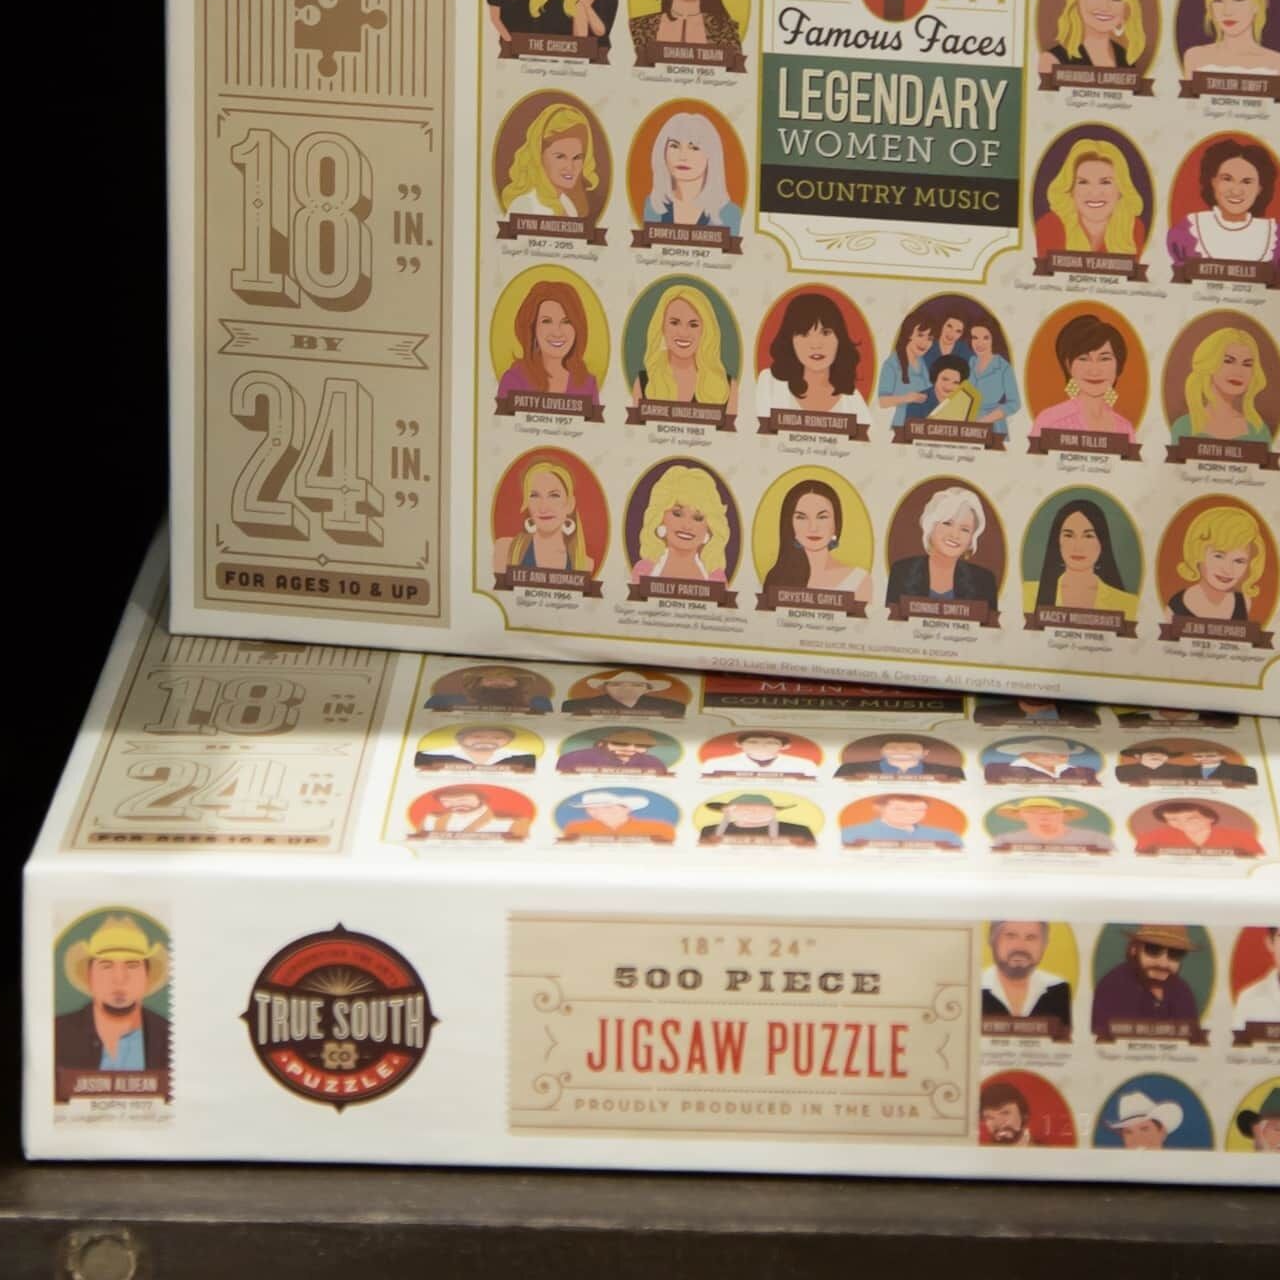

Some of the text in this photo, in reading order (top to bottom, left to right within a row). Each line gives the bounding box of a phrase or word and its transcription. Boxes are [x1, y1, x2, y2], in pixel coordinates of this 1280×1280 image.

[778, 7, 1007, 57] Famous Faces
[778, 67, 1008, 131] LEGENDARY
[777, 128, 1000, 167] WOMEN OF
[777, 179, 1000, 211] COUNTRY MUSIC
[230, 128, 433, 312] 18 IN.
[291, 334, 344, 352] BY
[230, 370, 430, 547] 24 IN.
[224, 570, 418, 601] FOR AGES 10 & UP
[144, 676, 305, 736] 18
[860, 699, 944, 709] MUSIC
[115, 759, 289, 822] 24
[614, 966, 881, 995] 500 PIECE
[255, 990, 424, 1049] TRUE SOUTH
[586, 1016, 909, 1079] JIGSAW PUZZLE
[287, 1063, 395, 1094] PUZZLE
[574, 1098, 920, 1120] PROUDLY PRODUCED IN THE USA
